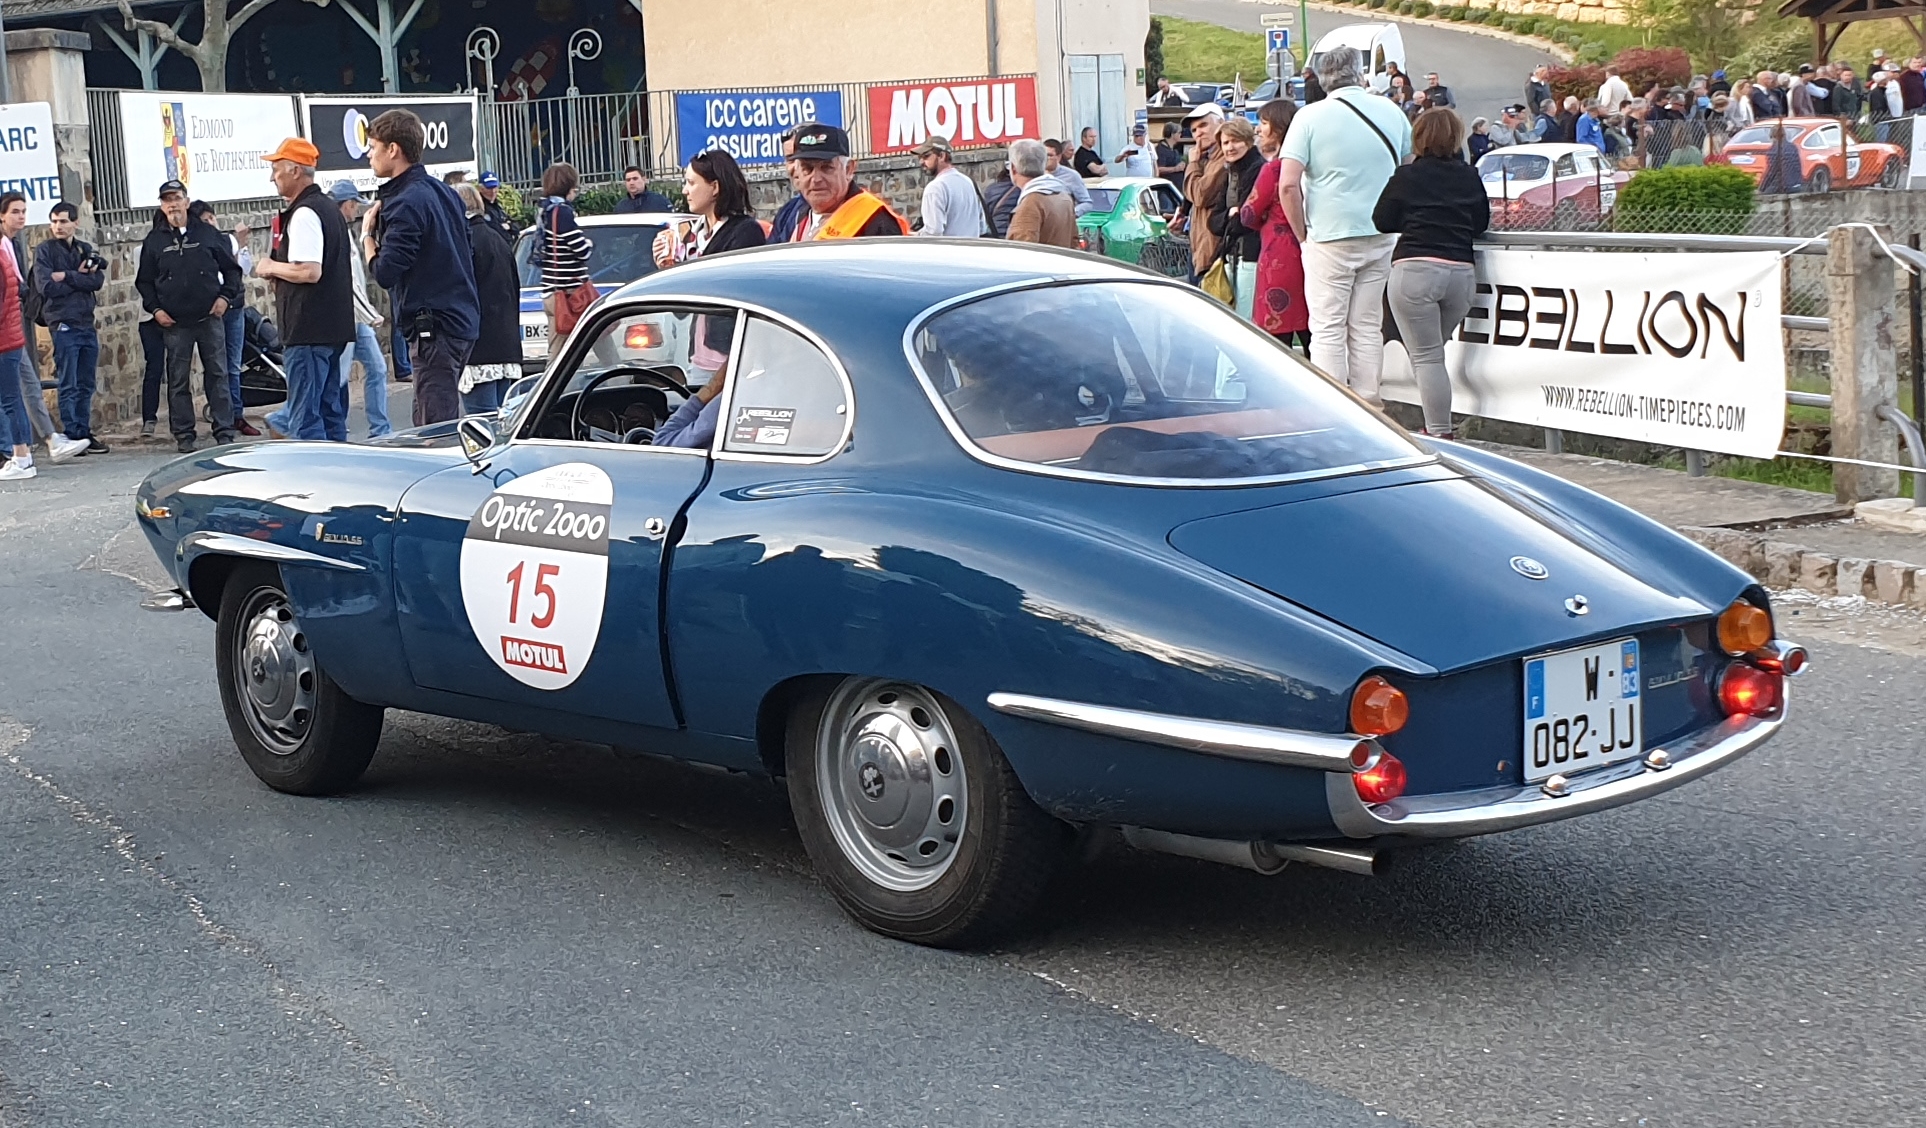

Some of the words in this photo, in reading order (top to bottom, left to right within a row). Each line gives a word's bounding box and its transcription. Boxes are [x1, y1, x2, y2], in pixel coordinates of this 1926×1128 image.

[739, 97, 816, 127] carene
[888, 83, 1024, 147] MOTUL
[706, 133, 783, 159] assuran
[1448, 283, 1747, 362] EBELLION
[1541, 384, 1745, 432] WWW.REBELLION-TIMEPIECES.COM
[481, 495, 544, 539] Optic
[543, 502, 606, 540] 2000
[506, 561, 560, 629] 15
[505, 640, 564, 669] MOTUL
[1621, 671, 1638, 694] 83
[1532, 695, 1539, 710] F
